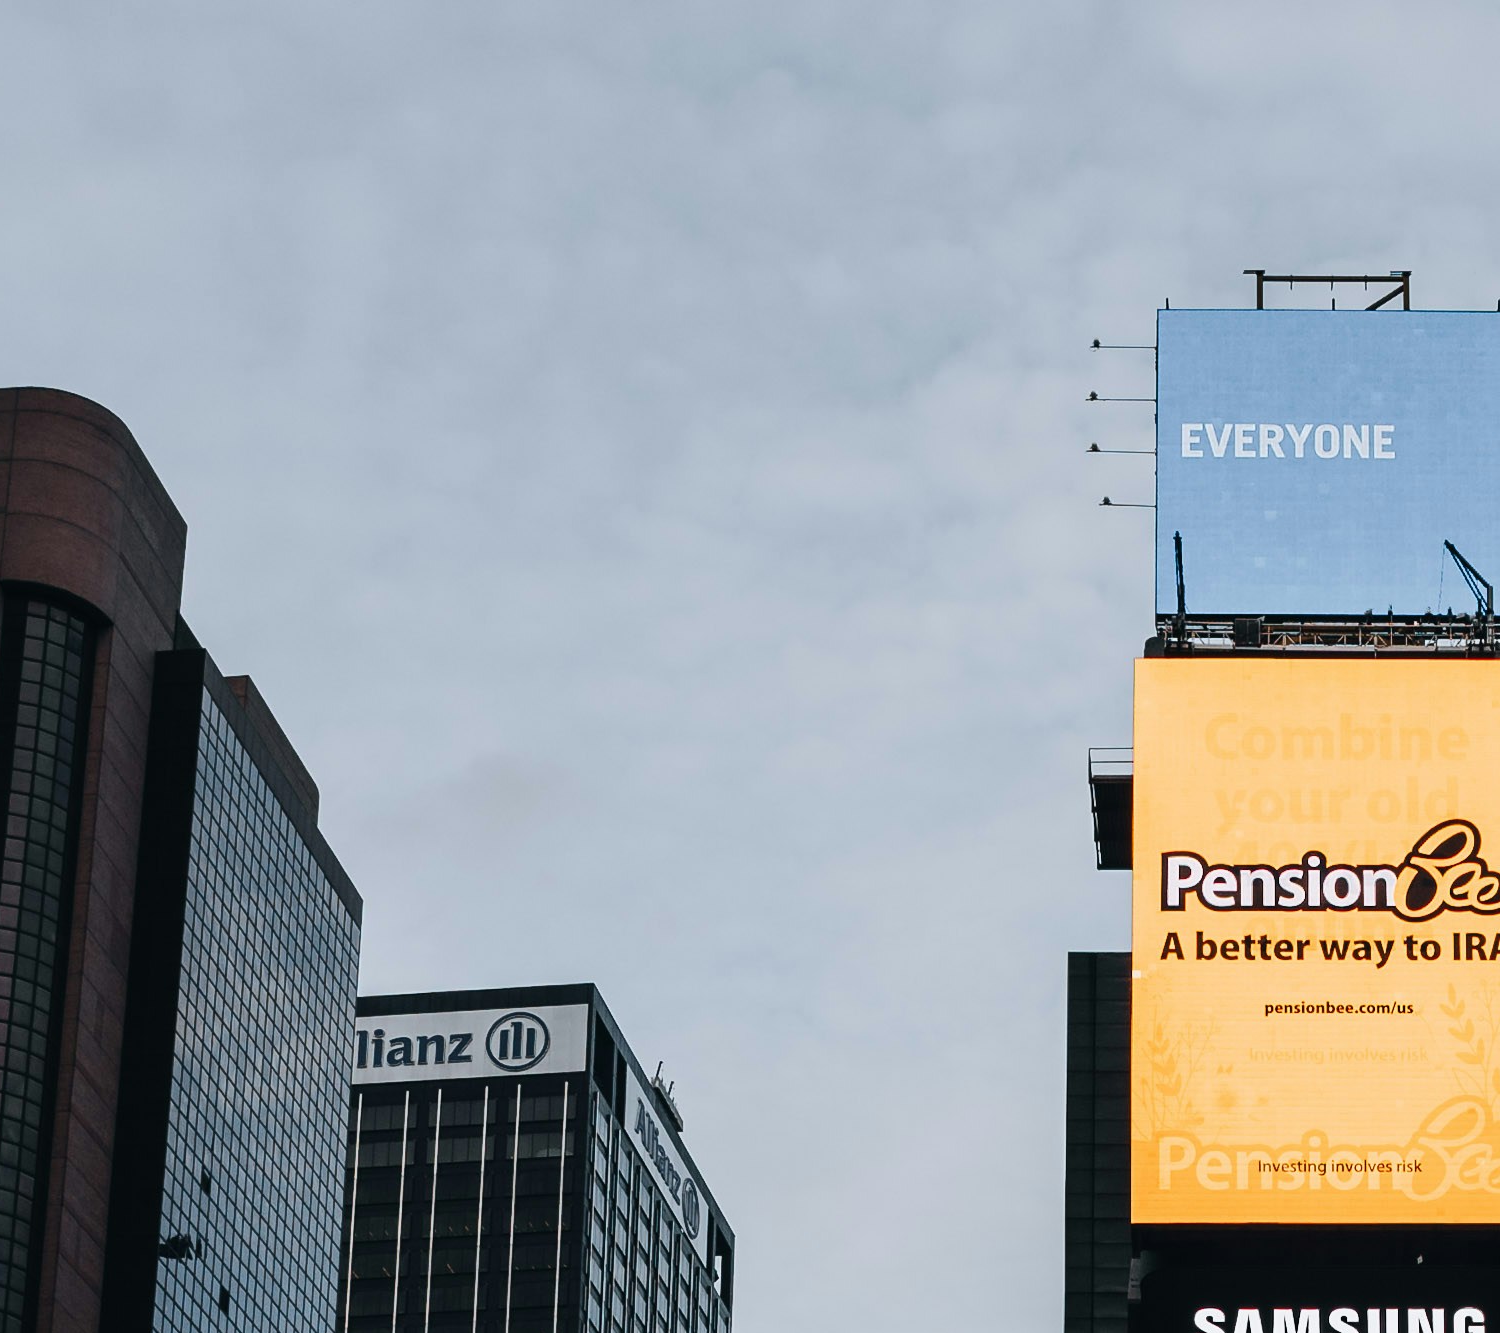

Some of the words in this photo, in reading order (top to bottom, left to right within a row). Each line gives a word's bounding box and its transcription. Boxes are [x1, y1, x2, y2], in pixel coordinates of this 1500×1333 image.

[1181, 423, 1396, 459] EVERYONE
[1205, 714, 1469, 761] Combine
[1161, 933, 1184, 961] A
[1196, 930, 1310, 961] better
[1320, 940, 1395, 969] way
[1404, 935, 1441, 961] to
[1265, 1002, 1414, 1017] pensionbee.com/us
[1257, 1158, 1327, 1176] Investing
[1330, 1158, 1392, 1173] involves
[1396, 1158, 1422, 1173] risk
